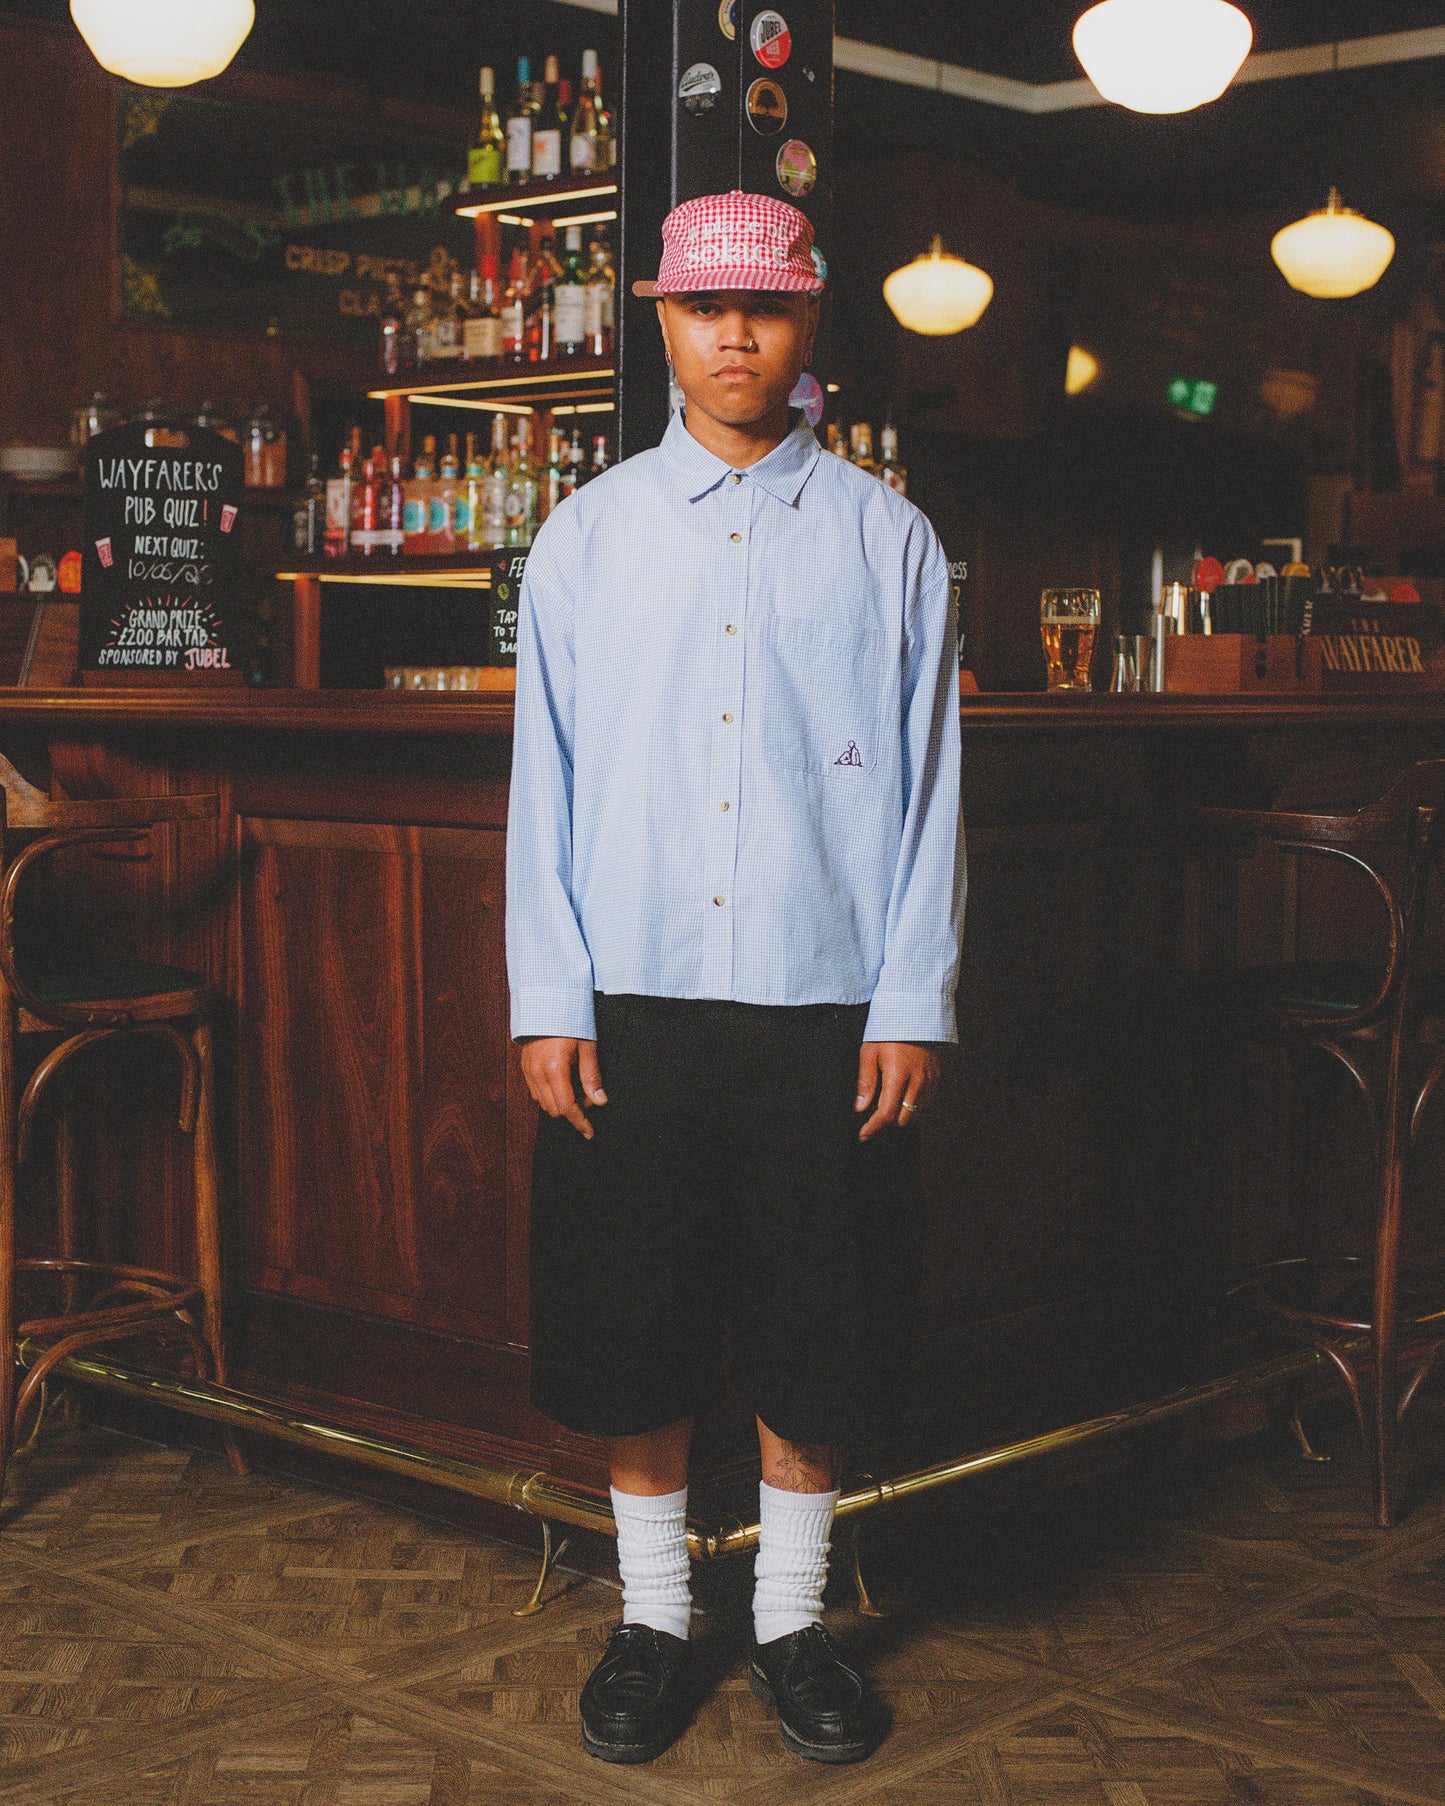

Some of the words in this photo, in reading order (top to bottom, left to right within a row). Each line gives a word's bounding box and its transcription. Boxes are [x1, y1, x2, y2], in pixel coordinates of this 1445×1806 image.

[701, 214, 763, 240] place
[767, 221, 788, 242] of
[685, 234, 790, 270] solace
[98, 458, 223, 492] WAYFARER'S
[124, 495, 157, 526] PUB
[134, 535, 168, 557] NEXT
[170, 536, 205, 560] QUIZ:
[128, 609, 168, 629] GRAND
[169, 609, 203, 630] PRIZE
[493, 625, 506, 638] TO
[117, 627, 154, 646] £200
[156, 629, 183, 647] BAR
[183, 628, 209, 647] TAB
[97, 648, 163, 666] SPONSORED
[165, 650, 179, 666] BY
[183, 647, 232, 671] JUBEL
